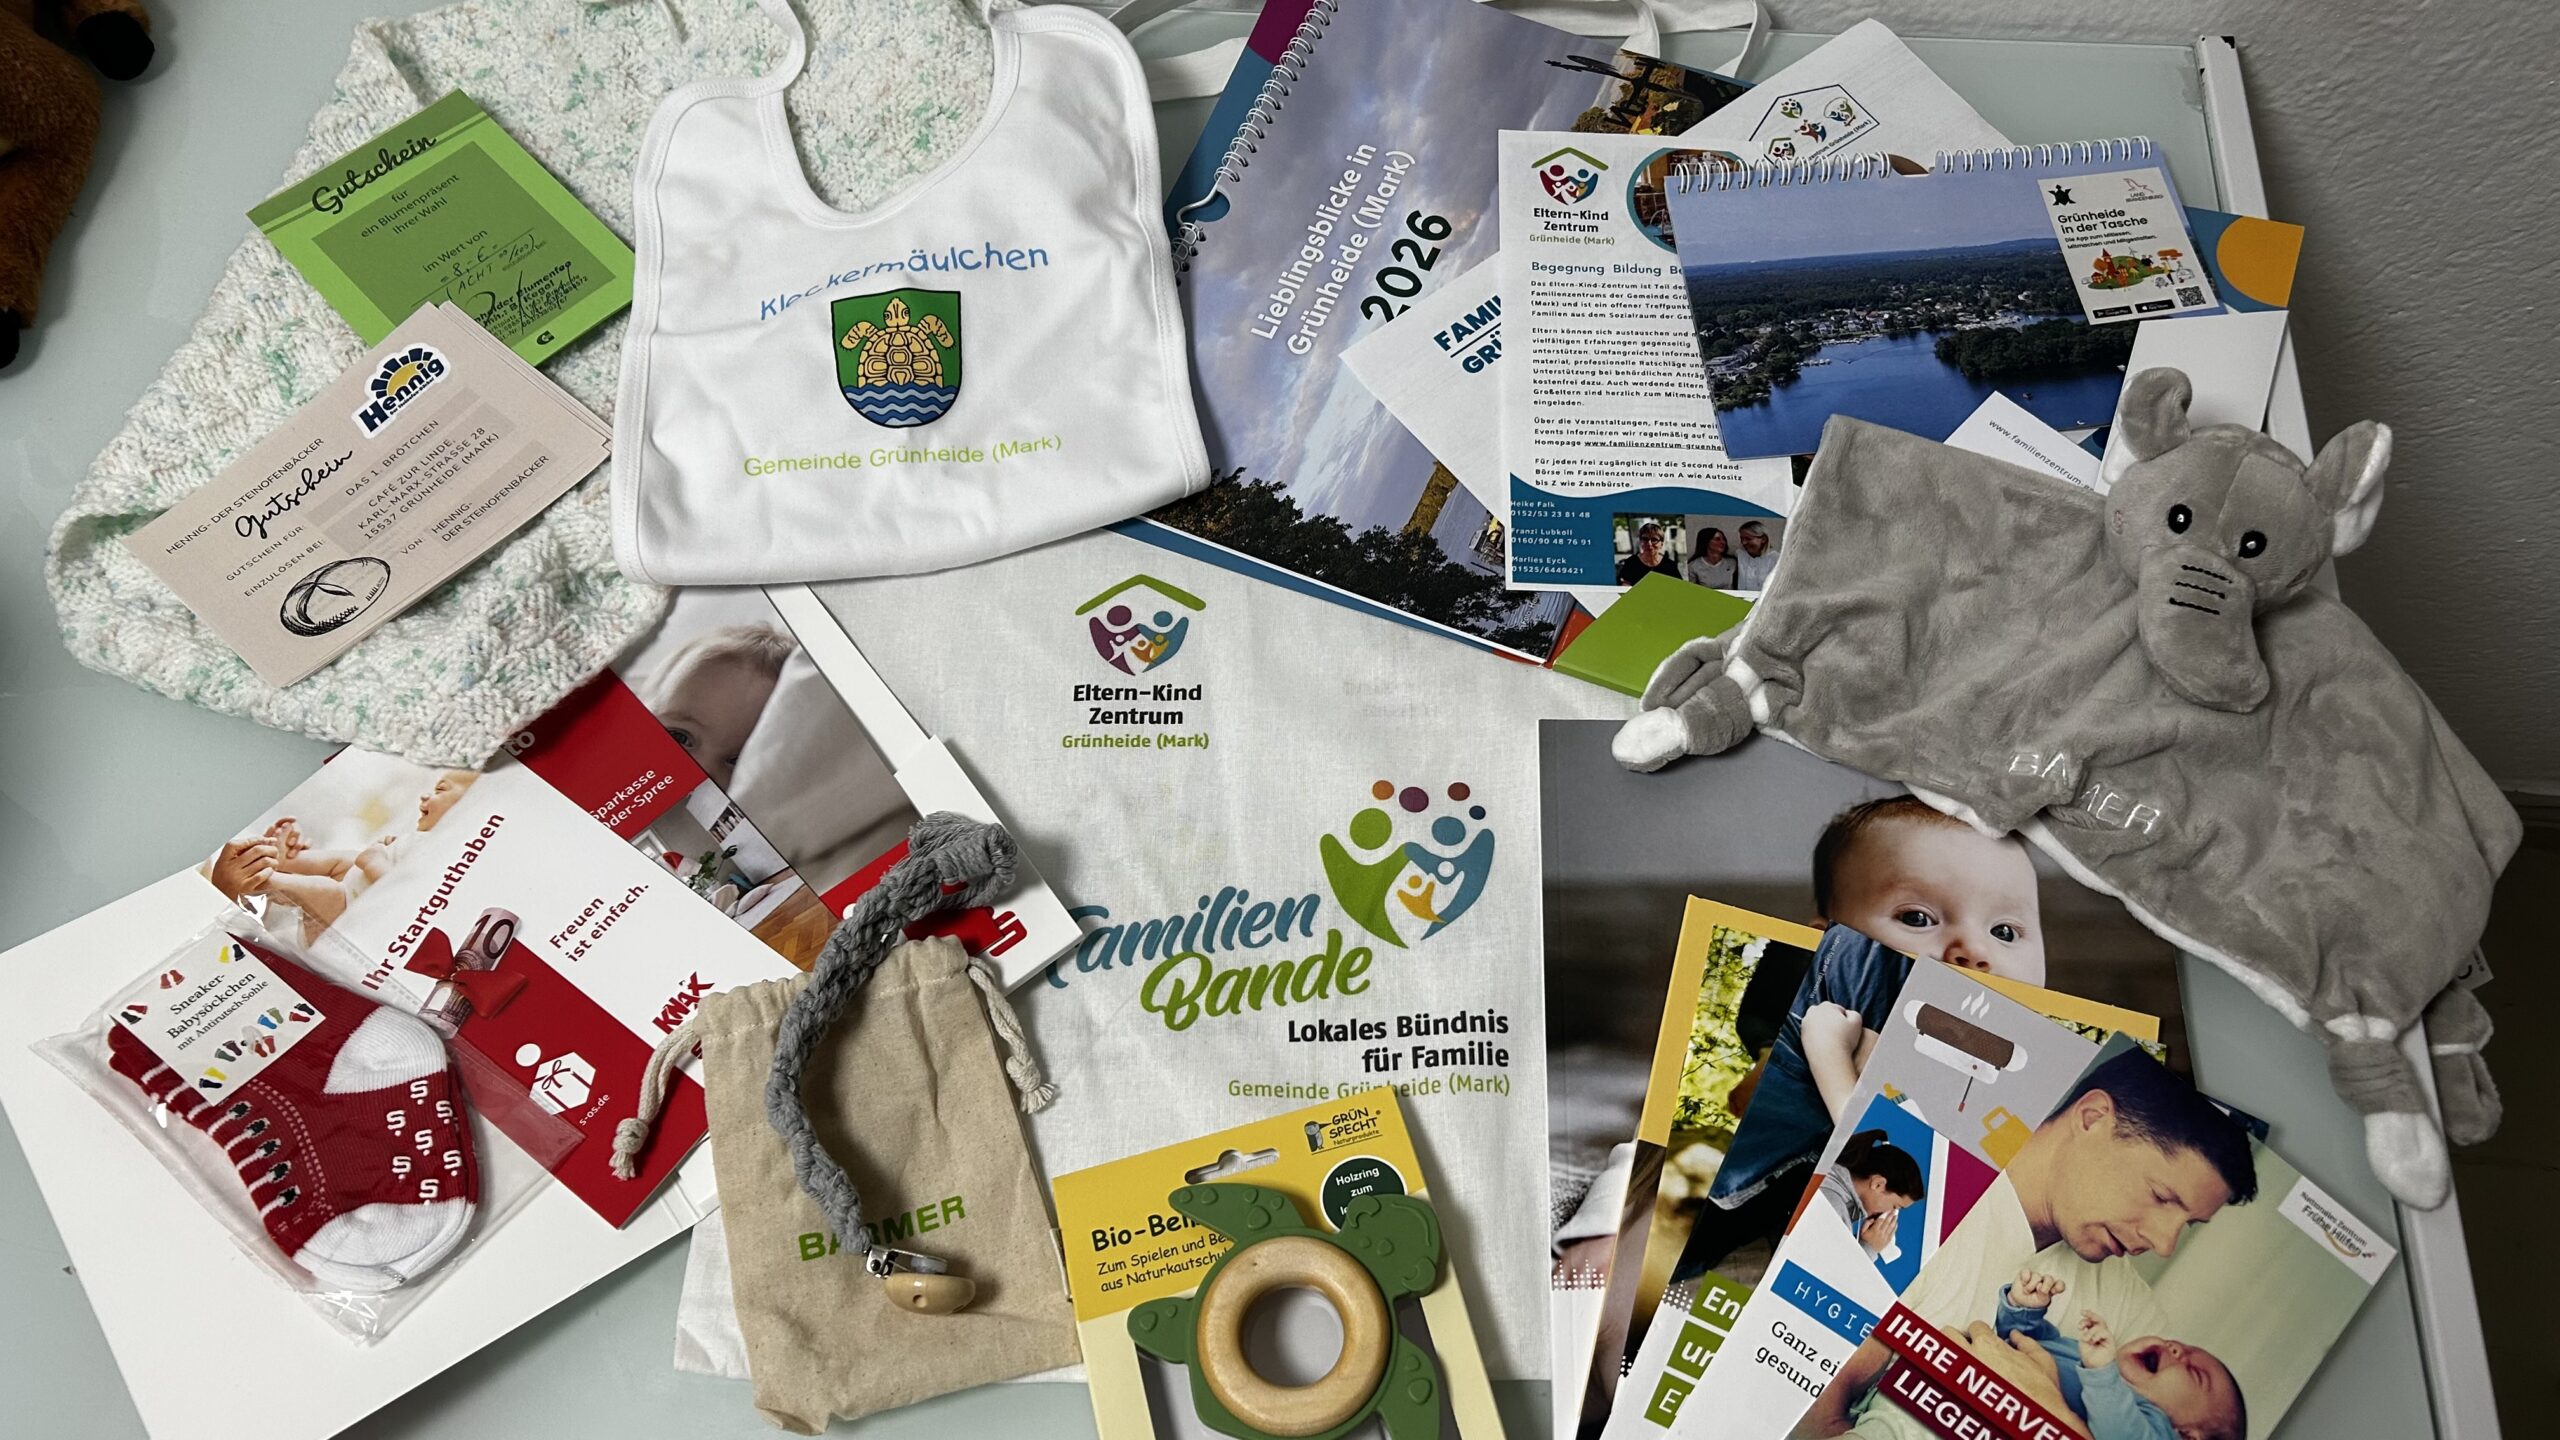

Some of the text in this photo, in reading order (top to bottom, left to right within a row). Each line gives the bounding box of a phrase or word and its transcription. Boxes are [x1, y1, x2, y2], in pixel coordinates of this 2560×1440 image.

[312, 137, 437, 215] Gutschein
[391, 190, 408, 202] für
[361, 174, 459, 238] ein Blumenpräsent
[392, 197, 447, 234] Ihrer Wahl
[1534, 208, 1609, 221] Eltern-Kind
[1544, 221, 1598, 232] Zentrum
[2057, 209, 2125, 223] Grünheide
[2061, 217, 2148, 234] in der Tasche
[423, 260, 439, 272] im
[438, 242, 465, 262] Wert
[465, 230, 488, 244] von
[1250, 144, 1377, 339] Lieblingsblicke in
[1287, 151, 1415, 354] Grünheide (Mark)
[1529, 234, 1615, 245] Grünheide (Mark)
[1360, 210, 1452, 322] 2026
[1532, 262, 1605, 275] Begegnung
[1614, 264, 1661, 276] Bildung
[358, 358, 445, 432] Hennig
[346, 477, 370, 496] DAS
[382, 420, 439, 467] BRÖTCHEN
[368, 440, 456, 508] CAFÉ ZUR LINDE,
[744, 435, 1062, 476] Gemeinde Grünheide (Mark)
[165, 438, 324, 554] HENNIG- DER STEINOFENBÄCKER
[235, 451, 353, 539] Gutschein
[358, 428, 486, 530] KARL-MARX-STRASSE 28
[364, 433, 499, 540] 15537 GRÜNHEIDE (MARK)
[441, 455, 549, 542] DER STEINOFENBÄCKER
[431, 502, 473, 534] HENNIG-
[226, 541, 282, 582] GUTSCHEIN
[244, 554, 305, 597] EINZULÖSEN
[1073, 684, 1202, 701] Eltern-Kind
[1089, 707, 1183, 724] Zentrum
[1062, 733, 1209, 749] Grünheide (Mark)
[361, 813, 505, 991] Ihr Startguthaben
[566, 882, 649, 963] ist einfach.
[467, 914, 514, 959] 10
[549, 897, 605, 949] Freuen
[170, 973, 226, 1016] Sneaker-
[1140, 928, 1372, 1031] Bande
[166, 972, 256, 1039] Babysöckchen
[177, 980, 269, 1051] mit Antirutsch-Sohle
[652, 971, 715, 1035] KNAX
[1288, 1008, 1509, 1042] Lokales Bündnis
[1362, 1040, 1509, 1073] für Familie
[1228, 1079, 1330, 1099] Gemeinde
[1449, 1072, 1510, 1096] (Mark)
[579, 1093, 610, 1126] s-os.de
[1329, 1117, 1377, 1139] SPECHT
[1332, 1107, 1369, 1125] GRÜN
[1333, 1129, 1379, 1146] Naturprodukte
[1336, 1167, 1380, 1186] Holzring
[1350, 1184, 1373, 1197] zum
[1097, 1260, 1126, 1275] Zum
[1131, 1246, 1179, 1267] Spielen
[1182, 1235, 1205, 1250] und
[1101, 1277, 1123, 1292] aus
[1772, 1321, 1818, 1362] Ganz
[1886, 1314, 1958, 1374] IHRE
